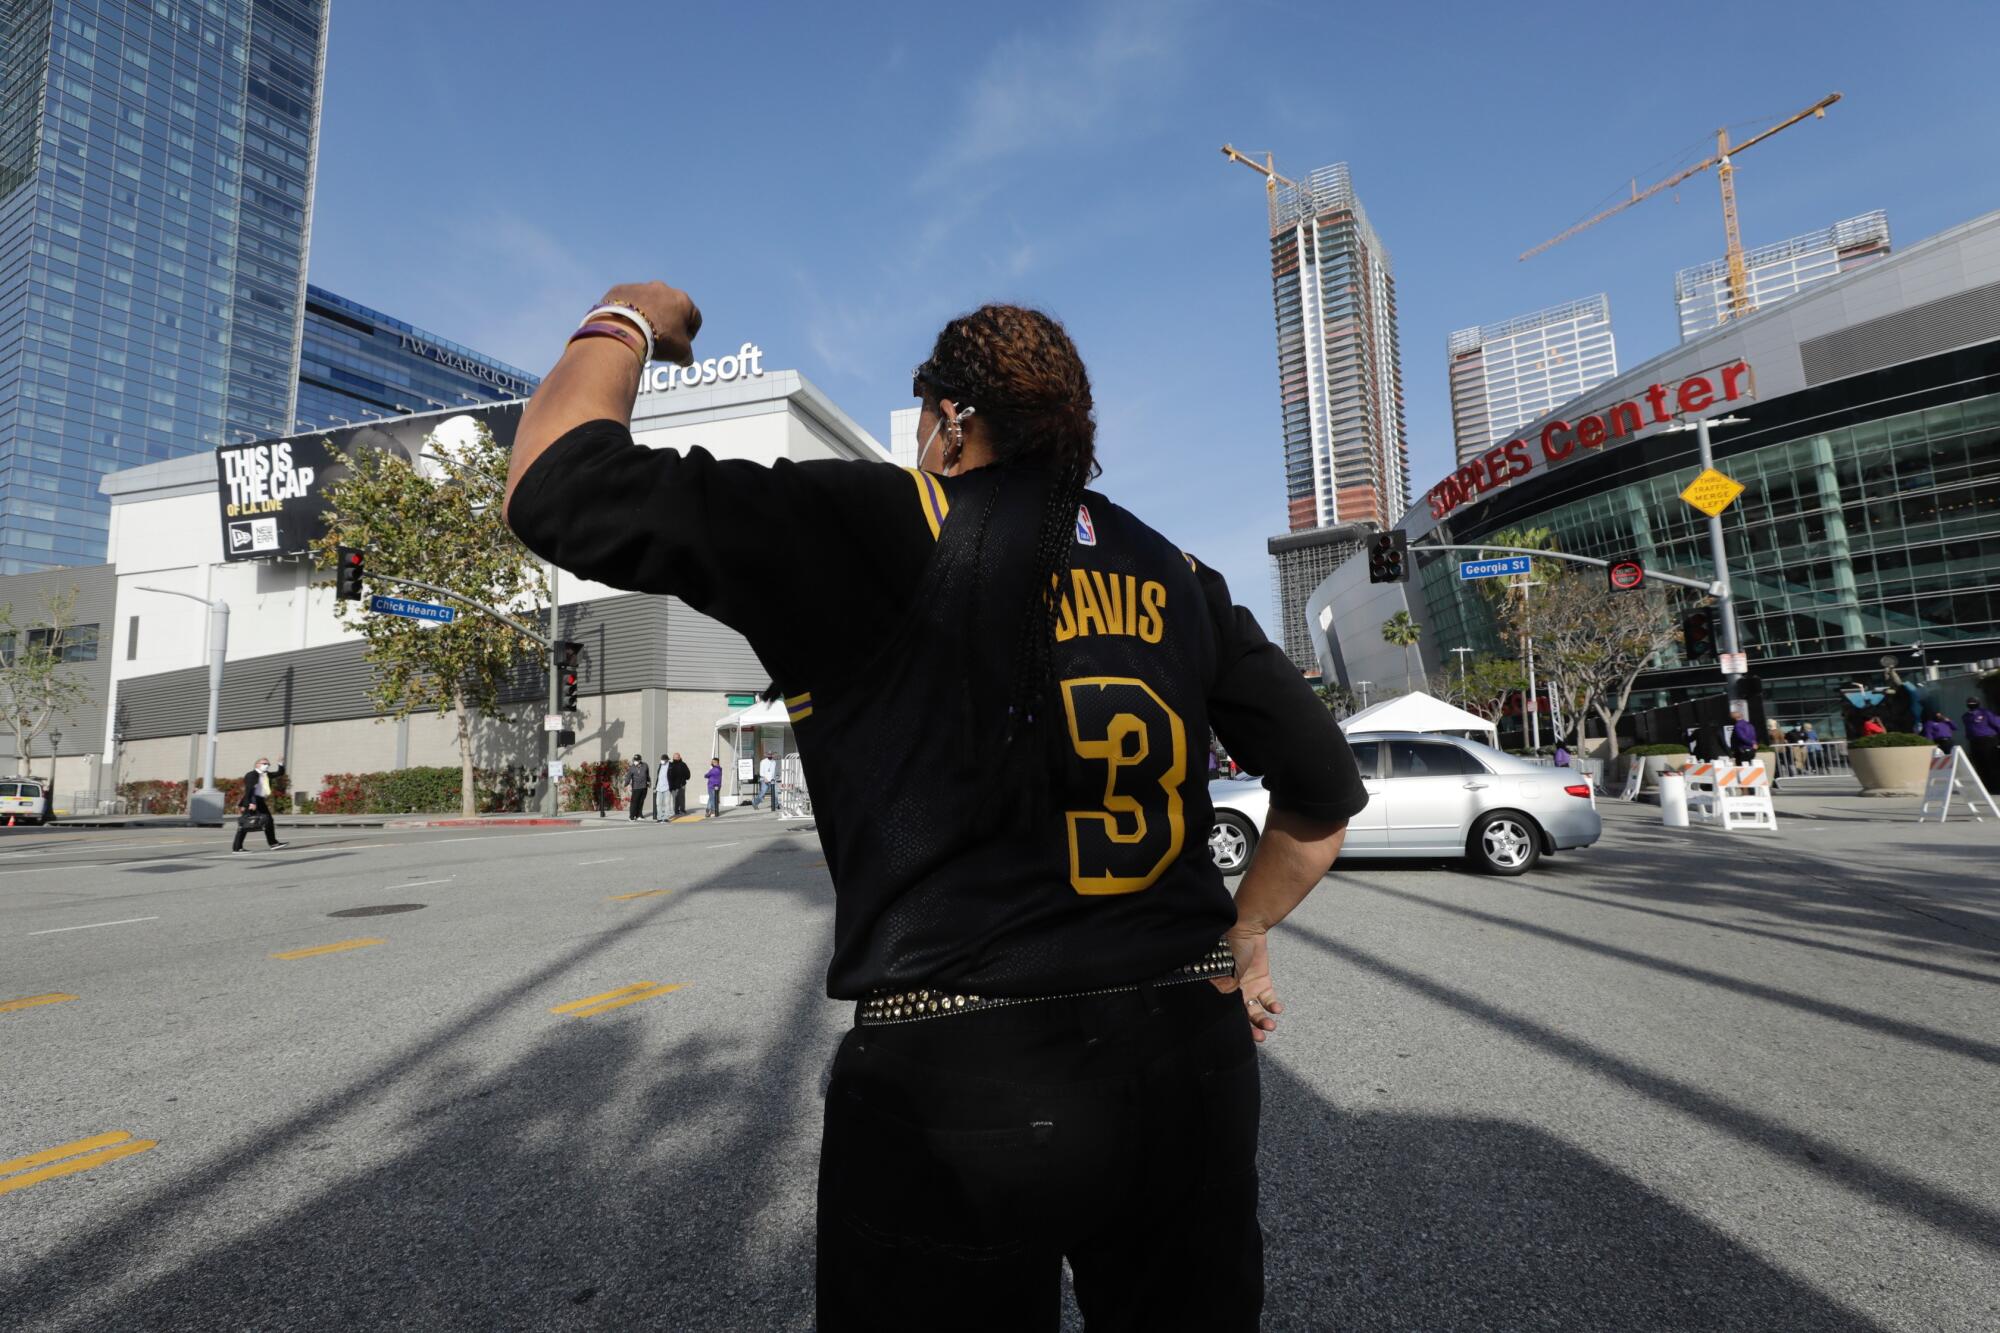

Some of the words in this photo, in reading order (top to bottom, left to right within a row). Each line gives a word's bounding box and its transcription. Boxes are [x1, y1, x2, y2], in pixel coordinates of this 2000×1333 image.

[400, 334, 430, 356] JW
[435, 348, 533, 396] MARRIOTT
[638, 342, 763, 393] icrosoft
[1426, 439, 1533, 520] STAPLES
[1541, 361, 1747, 462] Center
[221, 445, 270, 484] THIS
[271, 442, 294, 474] IS
[230, 474, 269, 506] THE
[270, 467, 314, 500] CAP
[1694, 483, 1730, 493] TRAFFIC
[1700, 476, 1722, 484] THRU
[1695, 491, 1730, 501] MERGE
[1702, 500, 1725, 509] LEFT
[226, 503, 241, 517] OF
[261, 499, 284, 513] LIVE
[1466, 562, 1508, 575] Georgia
[1512, 560, 1525, 570] St
[376, 599, 404, 612] Chick
[406, 603, 437, 617] Hearn
[438, 609, 450, 619] Ct
[1060, 677, 1187, 896] 3
